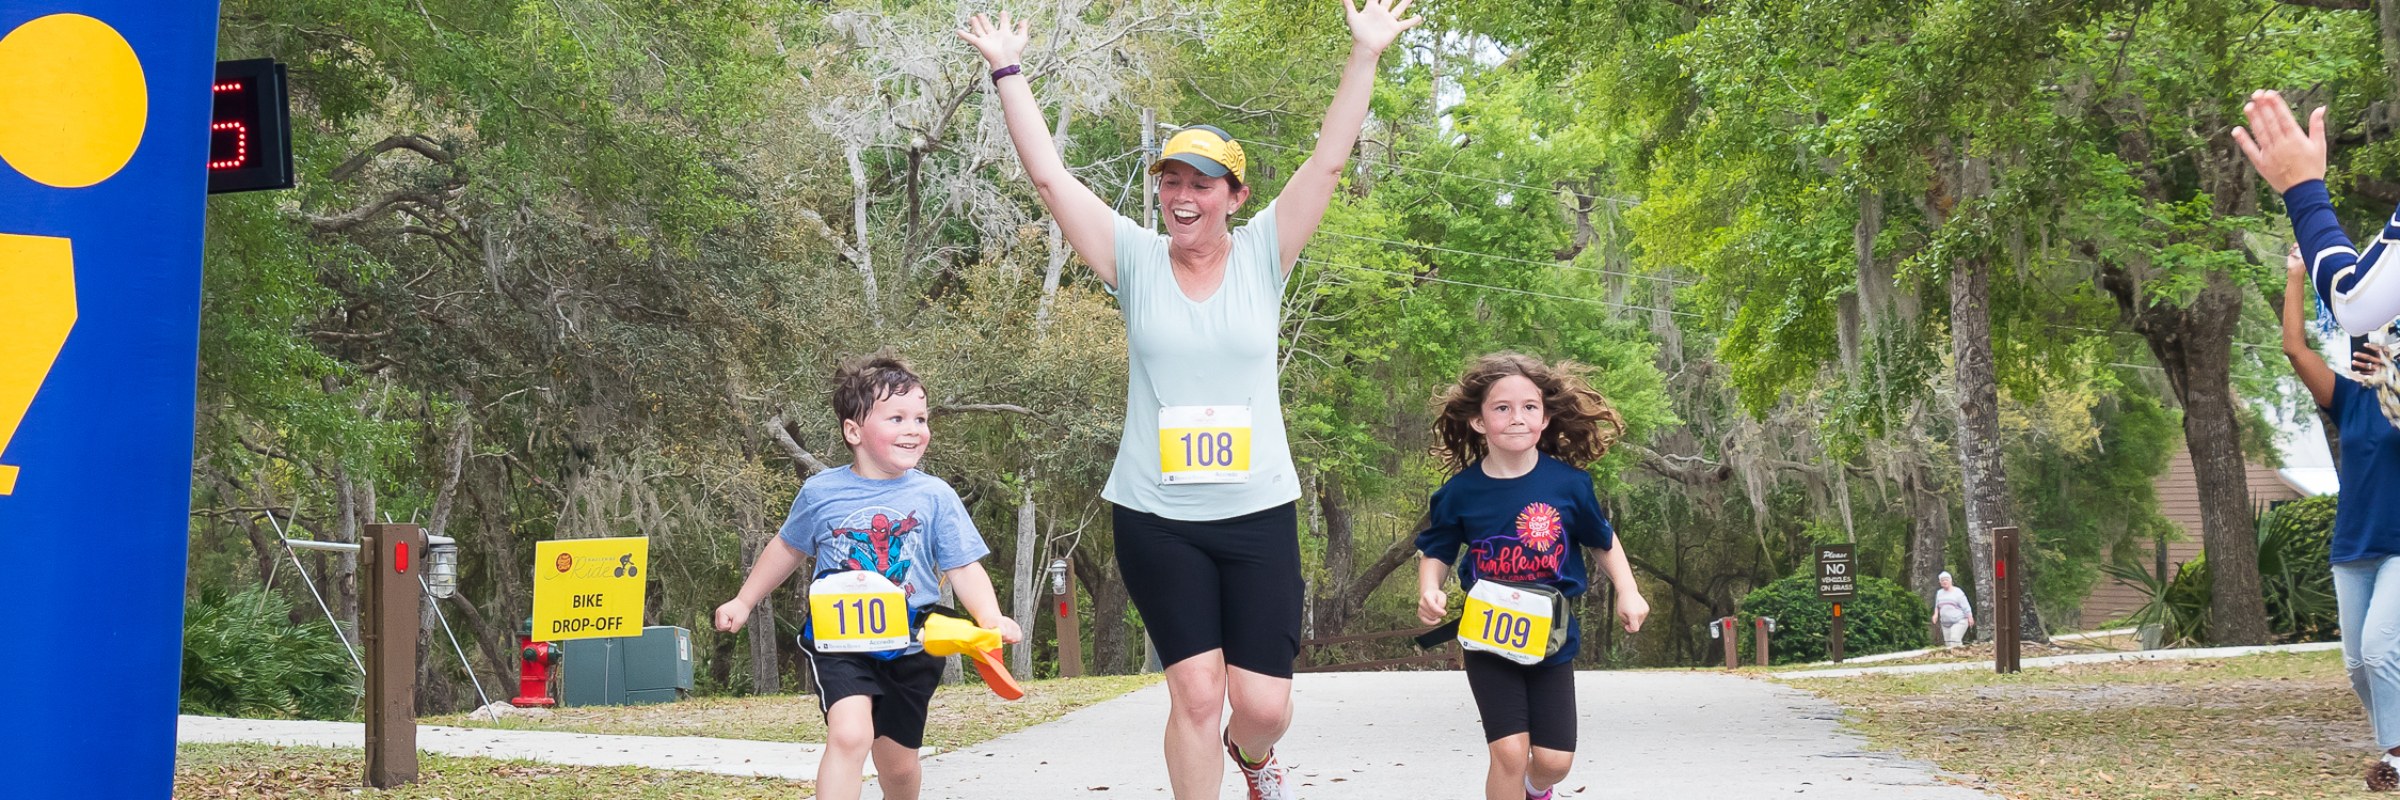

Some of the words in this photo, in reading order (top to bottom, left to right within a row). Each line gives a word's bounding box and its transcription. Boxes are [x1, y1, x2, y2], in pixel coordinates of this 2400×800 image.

[1181, 432, 1232, 466] 108
[1823, 550, 1848, 559] Please
[1826, 563, 1846, 575] NO
[572, 593, 604, 609] BIKE
[552, 616, 623, 634] DROP-OFF
[833, 598, 886, 635] 110
[1482, 609, 1531, 649] 109
